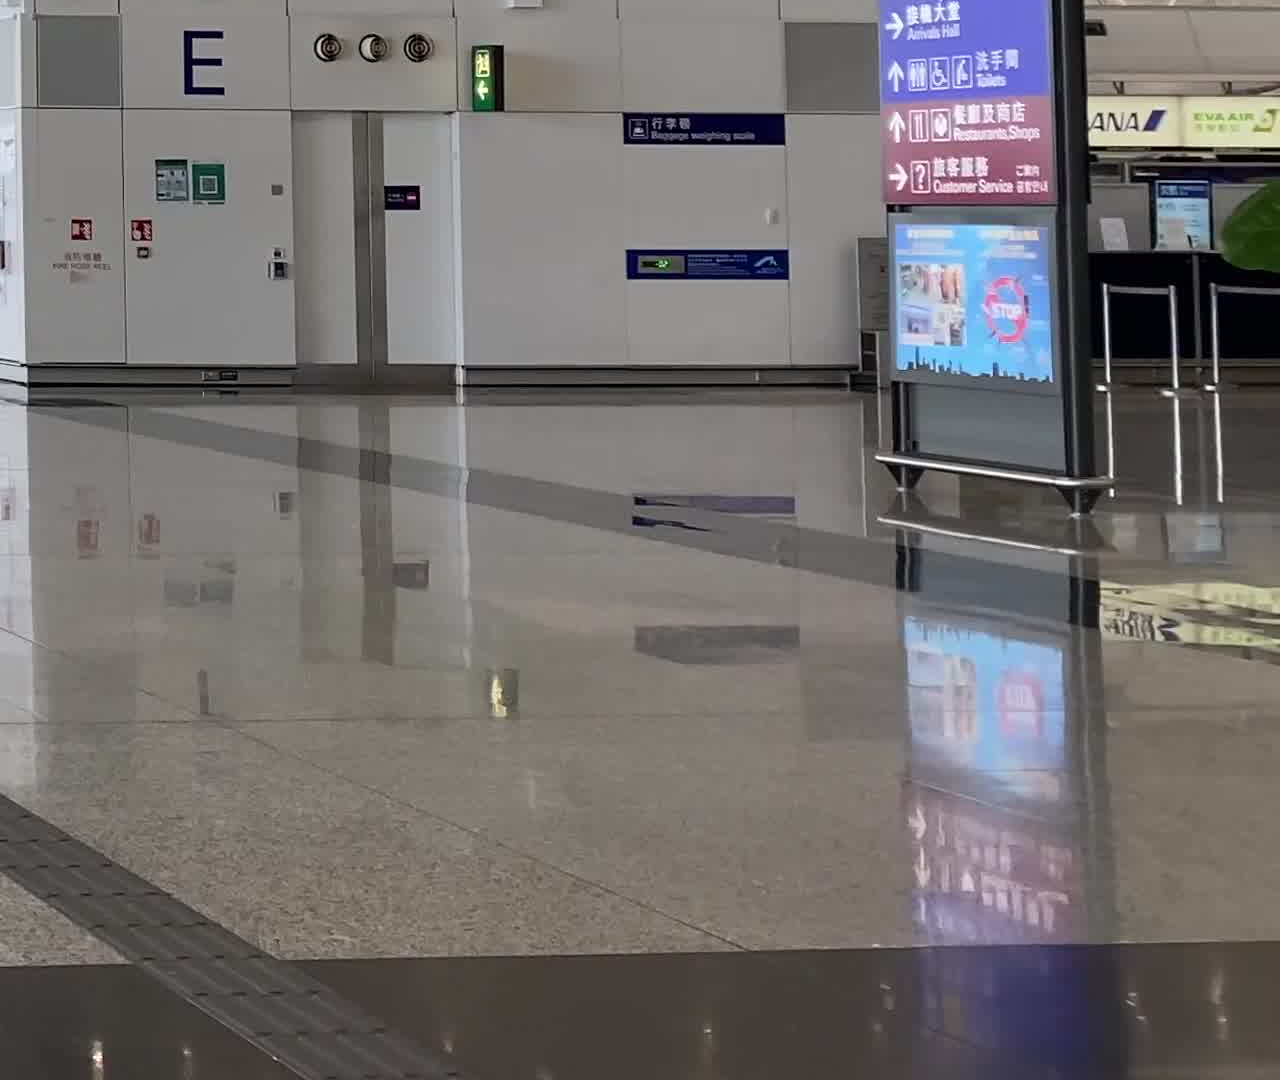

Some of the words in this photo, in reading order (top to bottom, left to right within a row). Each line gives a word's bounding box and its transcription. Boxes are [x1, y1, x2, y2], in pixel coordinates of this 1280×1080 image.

[907, 26, 940, 40] Arrivals
[942, 23, 960, 38] Hall
[183, 30, 225, 96] E
[976, 73, 1007, 88] Toilets
[1090, 112, 1140, 132] ANA
[933, 180, 977, 194] Customer
[978, 179, 1013, 194] Service
